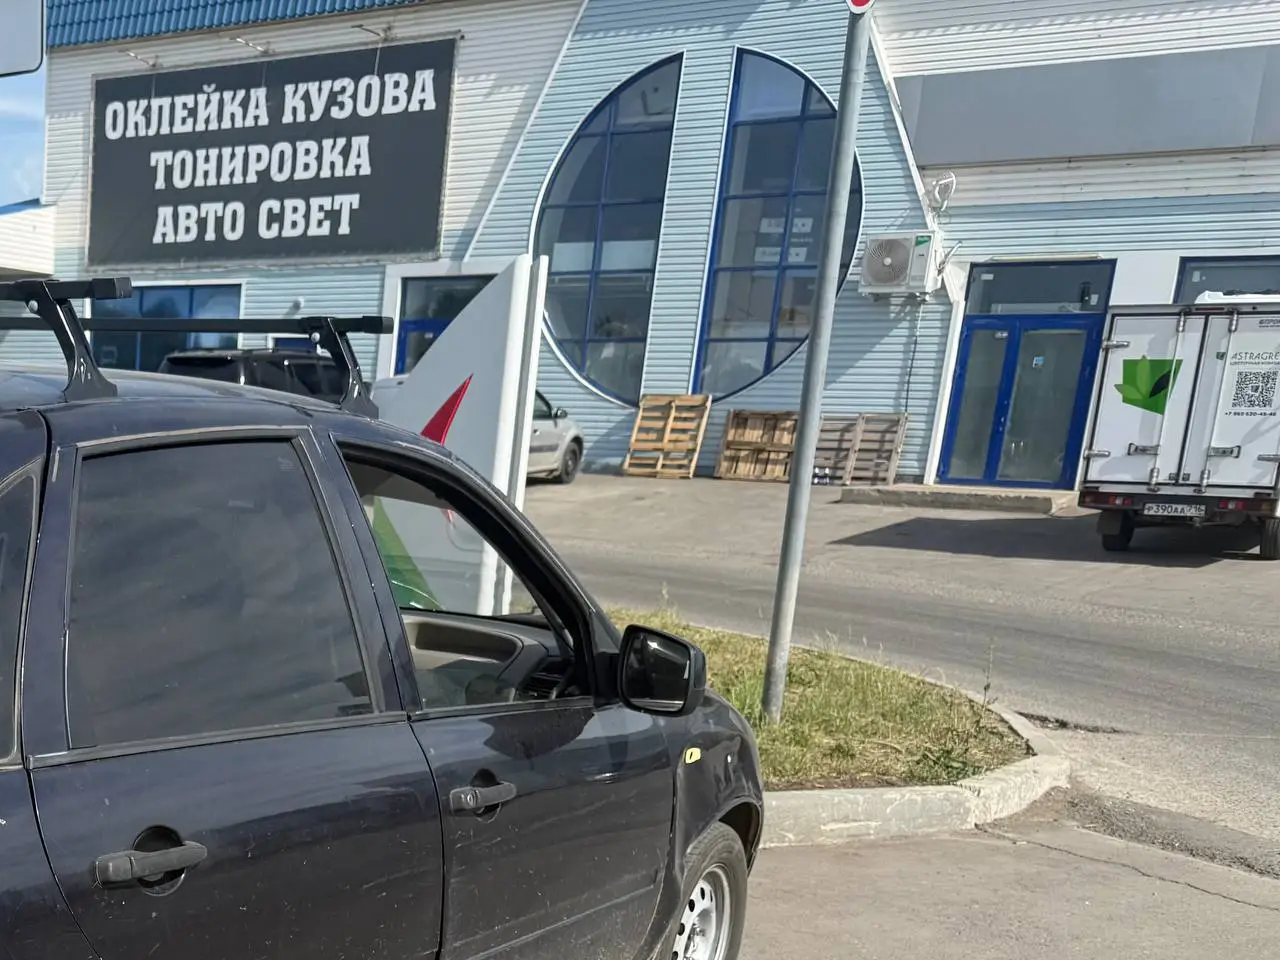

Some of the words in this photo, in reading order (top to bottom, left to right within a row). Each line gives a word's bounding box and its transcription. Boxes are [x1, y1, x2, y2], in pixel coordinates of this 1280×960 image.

[104, 83, 270, 140] ОКЛЕЙКА
[281, 69, 437, 124] КУЗОВА
[150, 135, 372, 190] ТОНИРОВКА
[152, 201, 245, 244] АВТО
[258, 193, 361, 239] СВЕТ
